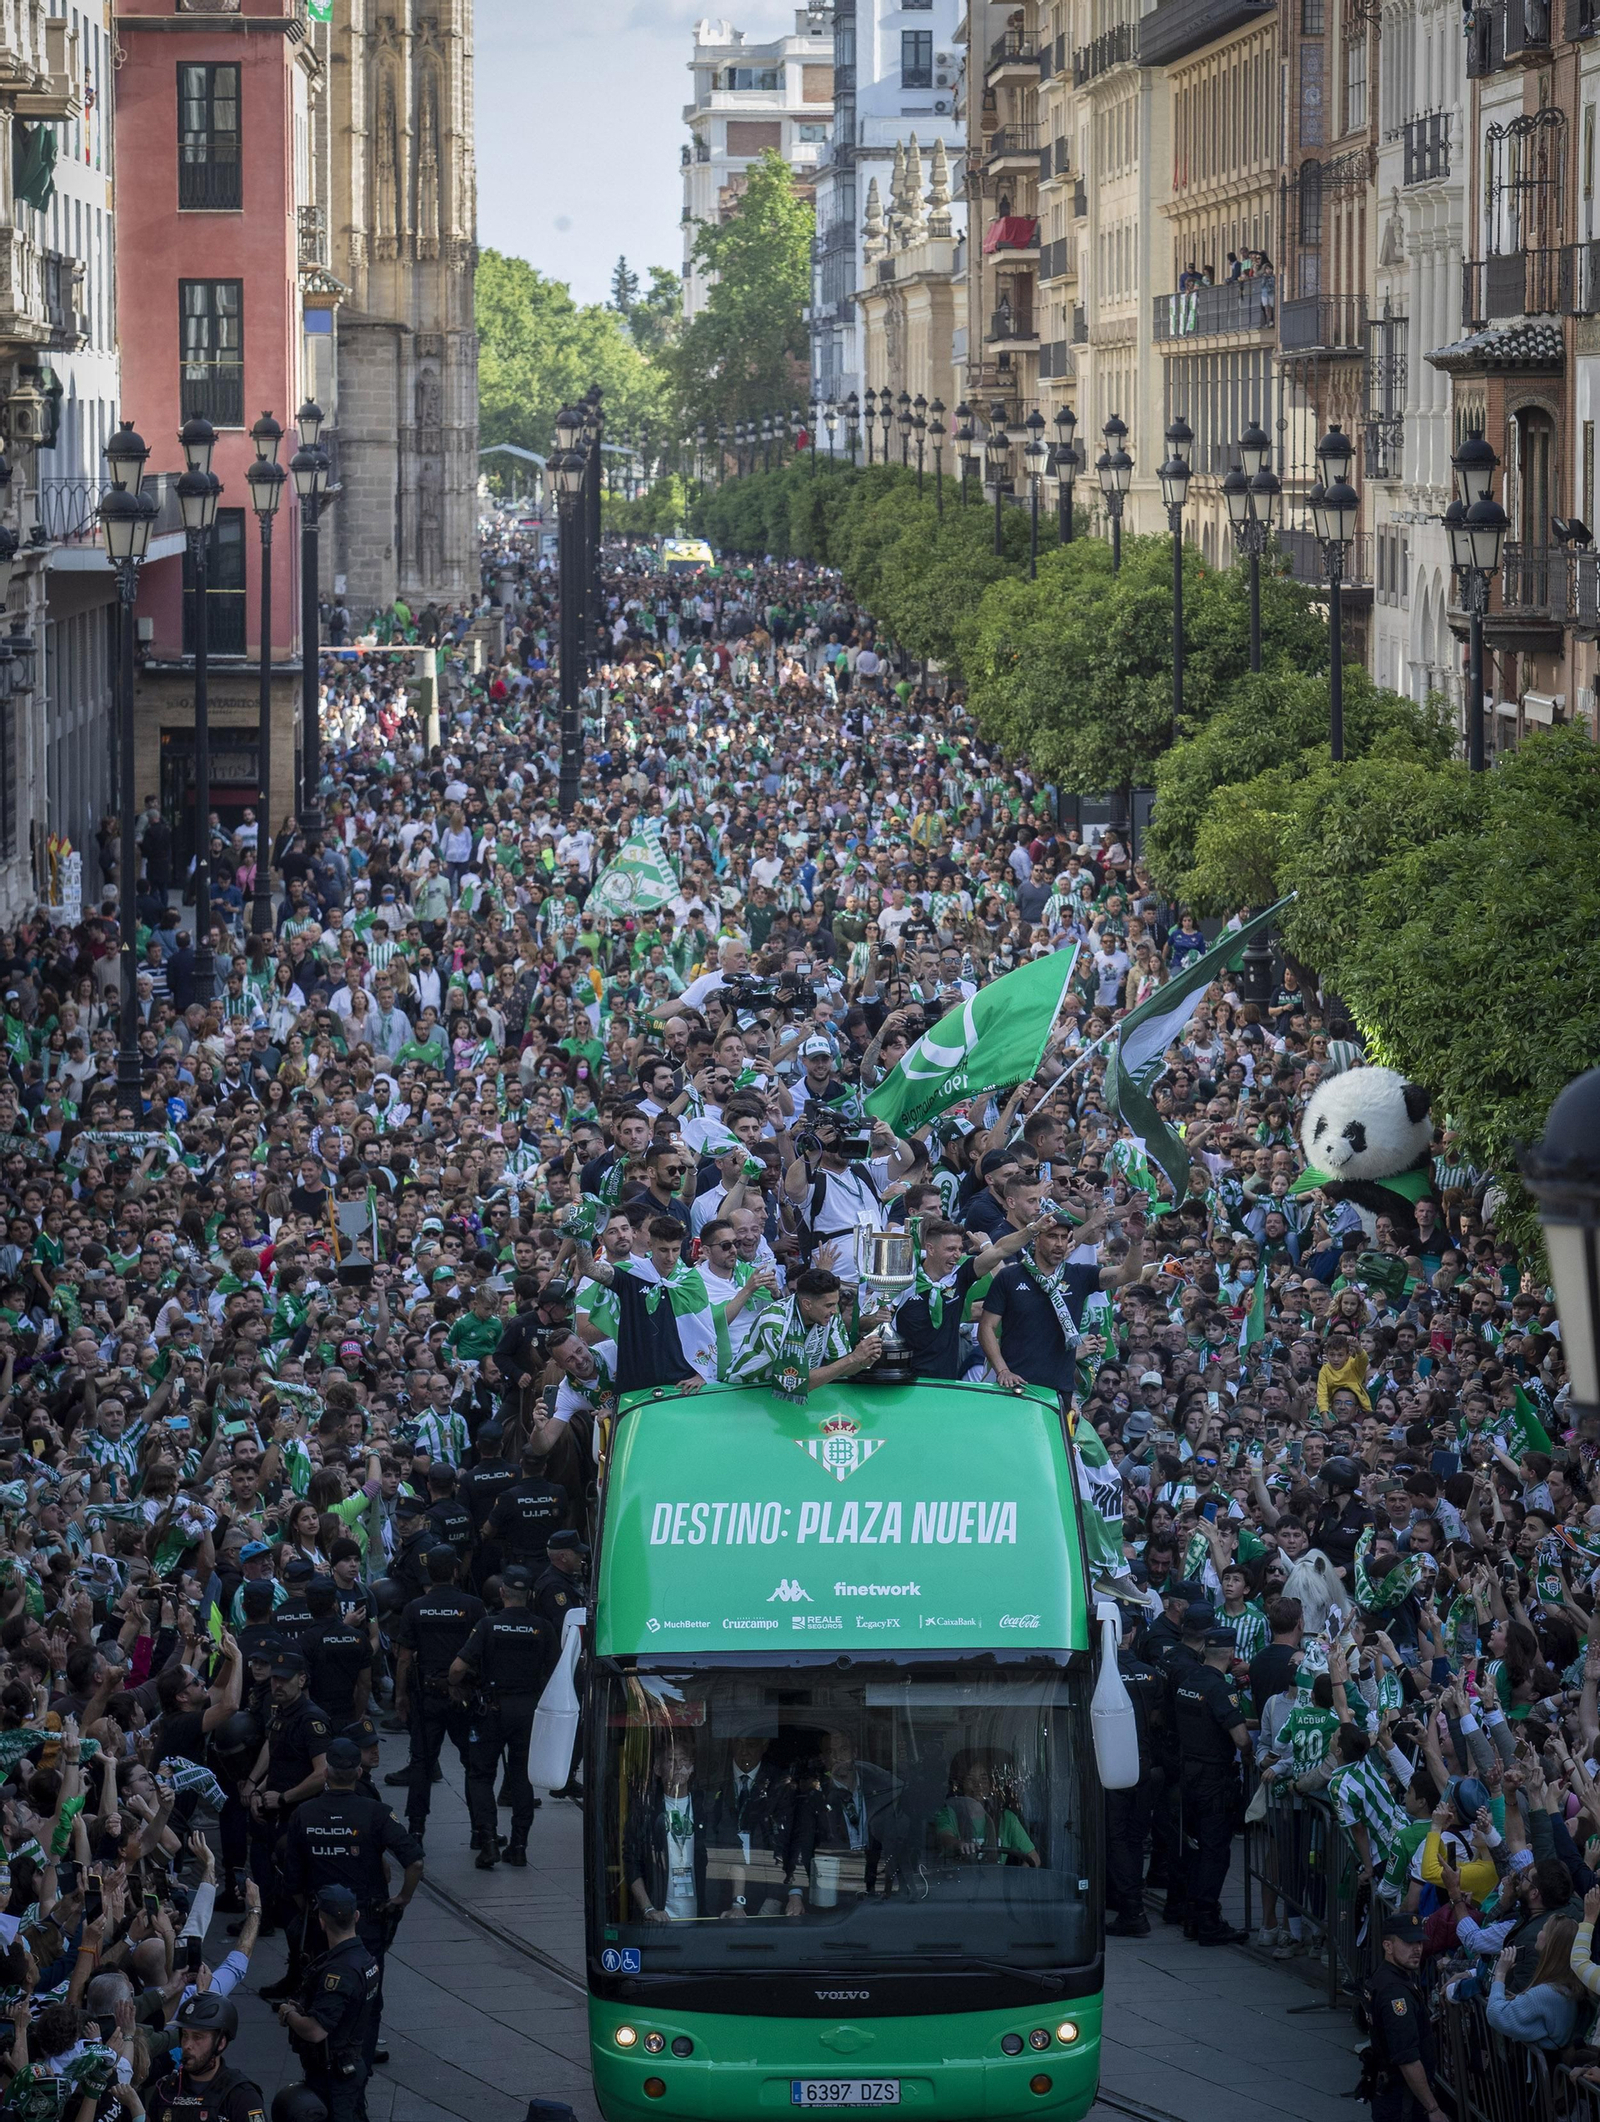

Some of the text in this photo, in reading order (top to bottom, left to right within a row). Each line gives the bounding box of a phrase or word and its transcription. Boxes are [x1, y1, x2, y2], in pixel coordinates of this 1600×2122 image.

[473, 1472, 509, 1481] POLICIA
[650, 1502, 1017, 1544] DESTINO: PLAZA NUEVA
[834, 1582, 922, 1596] finetwork
[277, 1613, 313, 1622] POLICI
[936, 1618, 977, 1626] CaixaBank
[664, 1620, 711, 1629] MuchBetter
[722, 1618, 778, 1630] Cruzcampo
[493, 1625, 534, 1633] POLICIA
[323, 1636, 357, 1644] POLICIA
[1176, 1688, 1200, 1699] POLICIA
[1294, 1728, 1323, 1760] 10
[306, 1827, 352, 1835] POLICIA
[311, 1847, 349, 1855] U.I.P.
[815, 1991, 870, 2000] VOLVO
[807, 2083, 895, 2101] 6397 DZS
